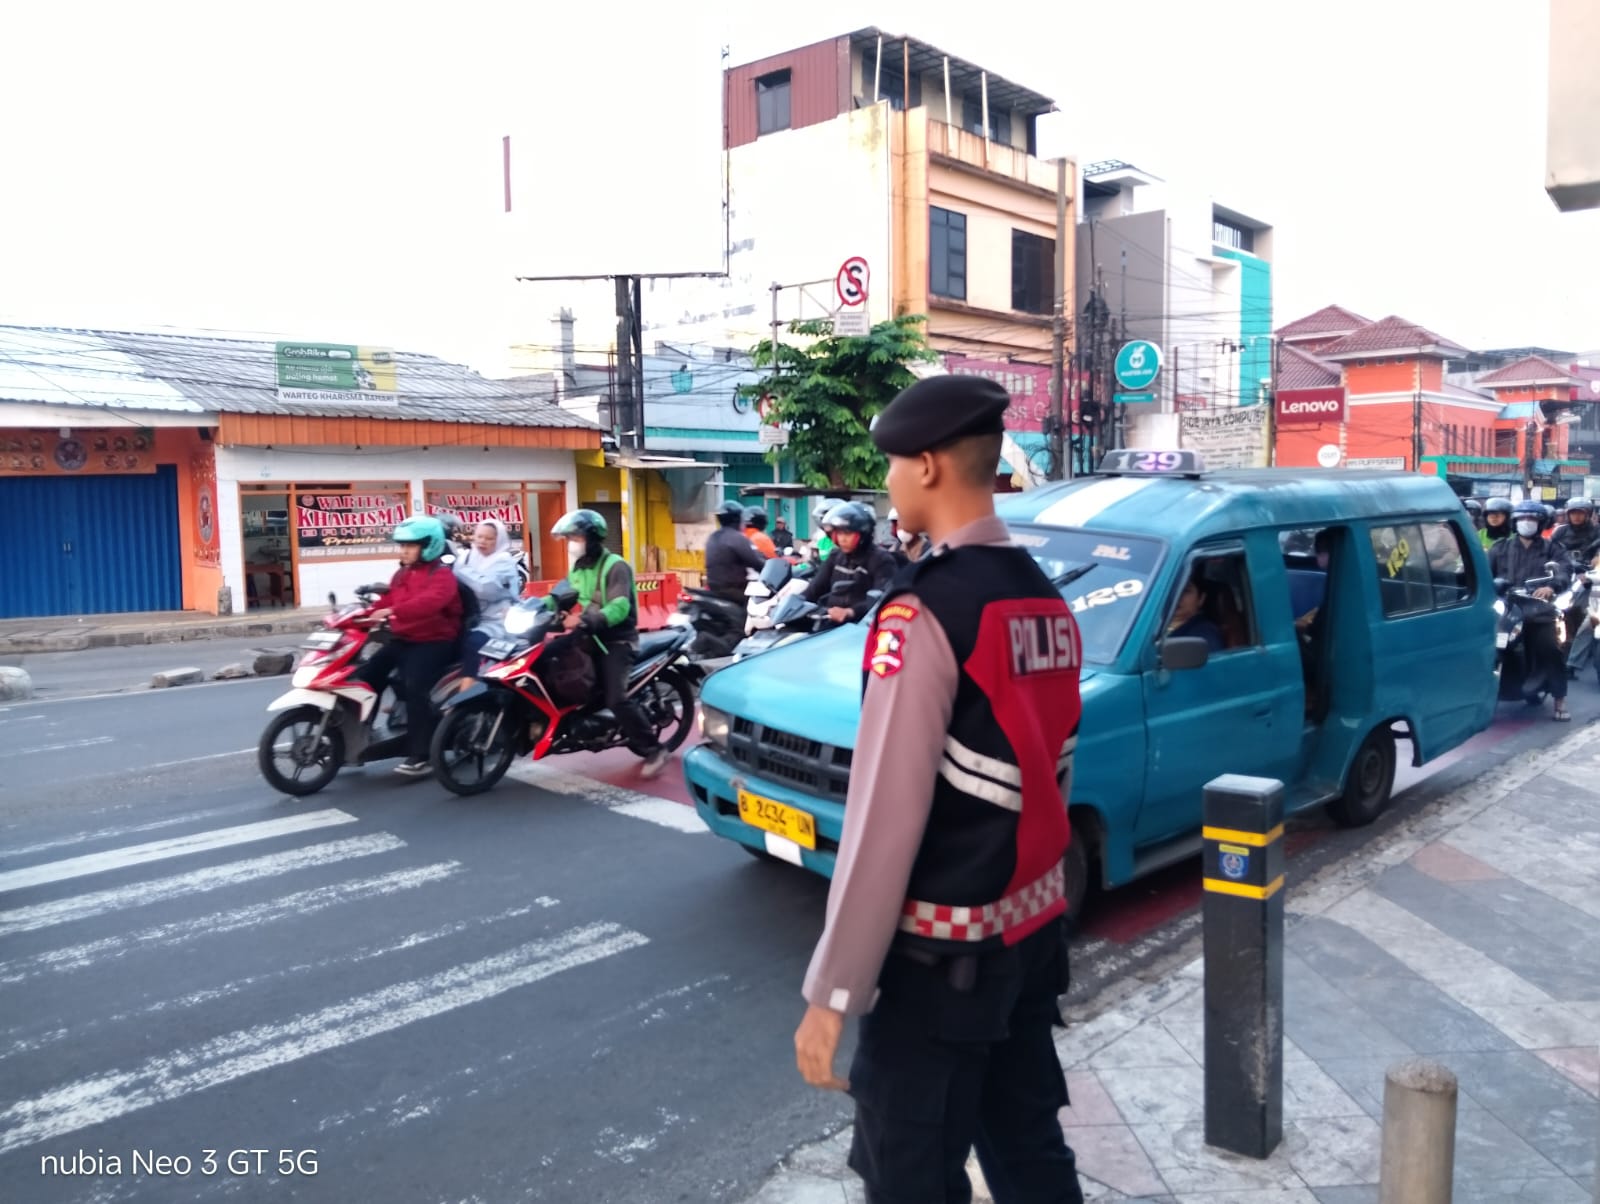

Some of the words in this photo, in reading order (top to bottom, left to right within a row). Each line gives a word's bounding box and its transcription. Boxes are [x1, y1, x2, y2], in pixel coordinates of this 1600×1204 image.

[282, 391, 318, 400] WARTEG
[320, 392, 362, 401] KHARISMA
[1281, 400, 1339, 413] Lenovo
[1116, 452, 1182, 471] 129
[316, 496, 386, 510] WARTEG
[296, 503, 406, 529] KHARISMA
[1071, 579, 1143, 613] 129
[1008, 617, 1078, 674] POLISI
